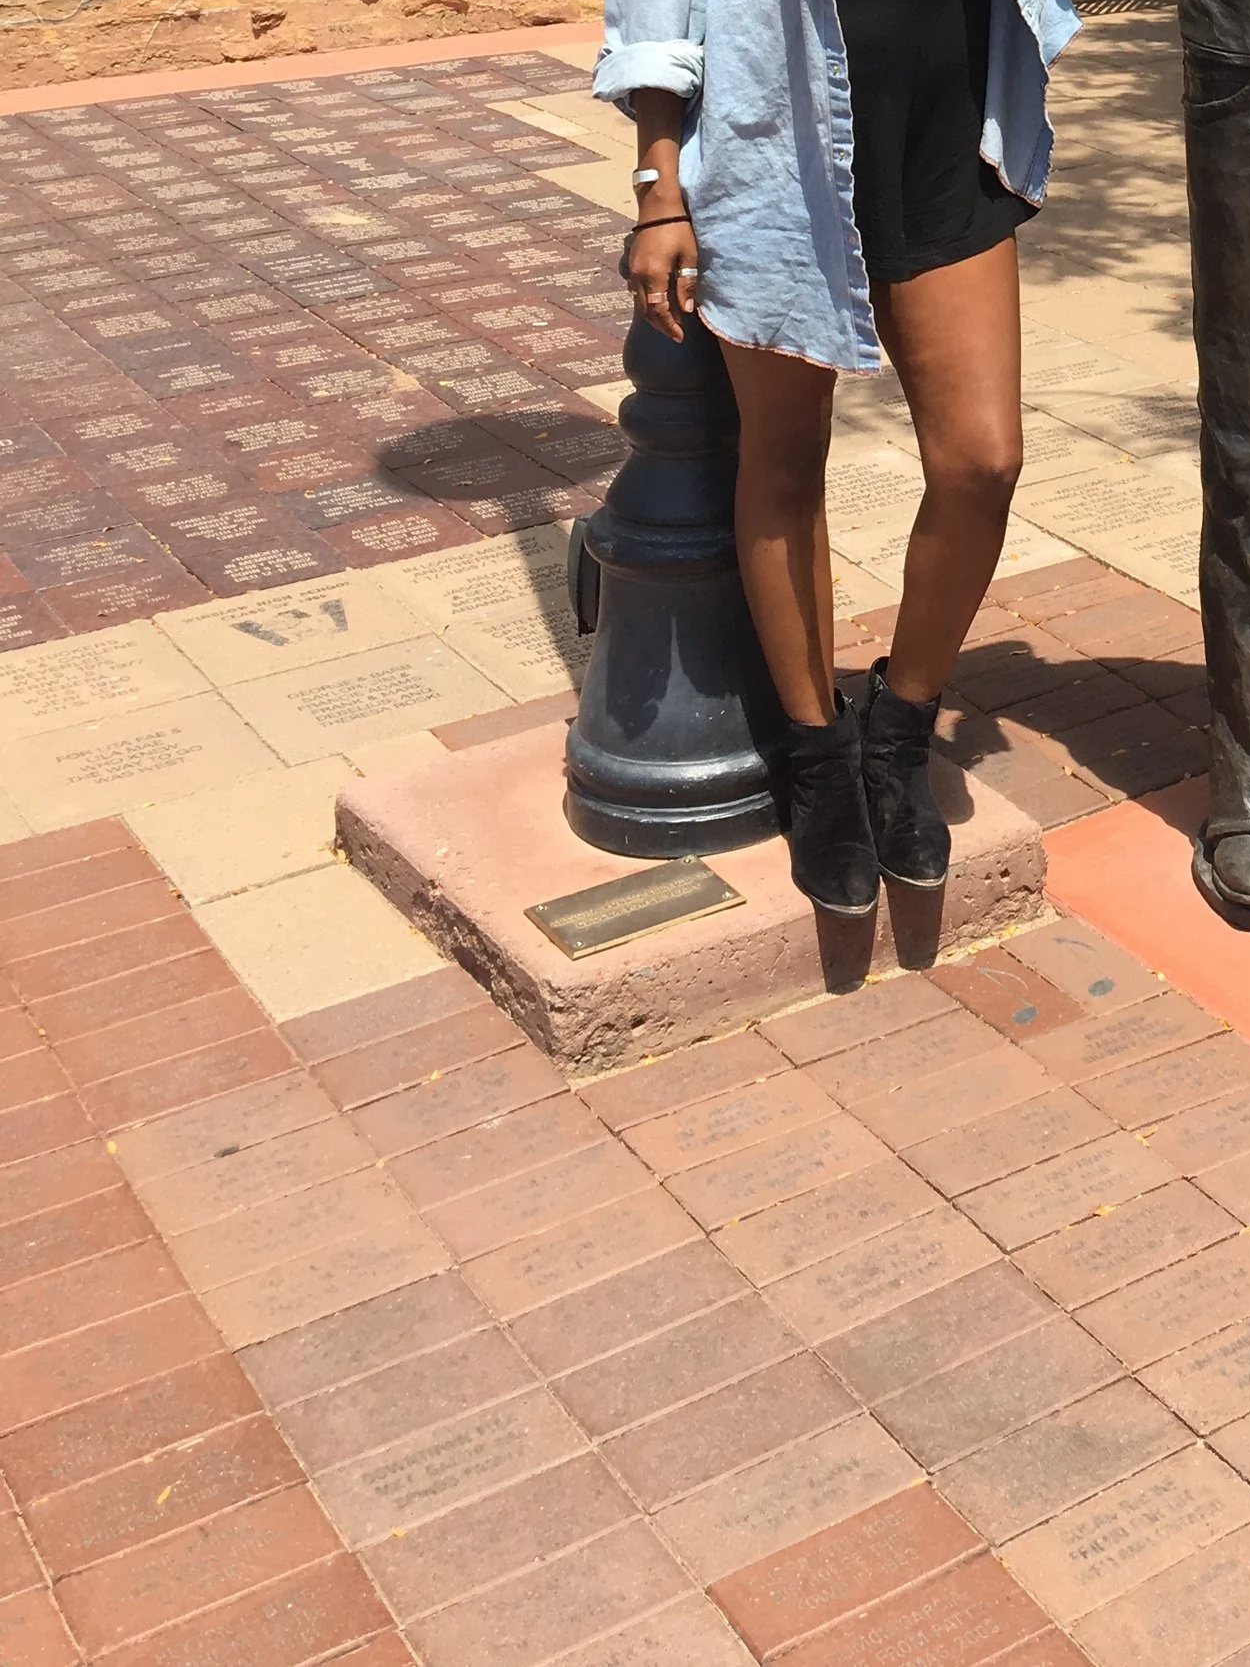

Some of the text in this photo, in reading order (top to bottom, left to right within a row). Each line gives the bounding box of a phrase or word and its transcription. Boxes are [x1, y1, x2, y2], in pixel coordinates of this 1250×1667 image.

[367, 675, 422, 692] ADAMS
[311, 698, 364, 715] FRANK
[126, 740, 163, 752] MAE
[56, 749, 92, 762] FOR
[68, 744, 203, 783] THE WAY TO GO
[80, 743, 180, 772] WHO KNEW
[94, 756, 186, 784] WAS WEST
